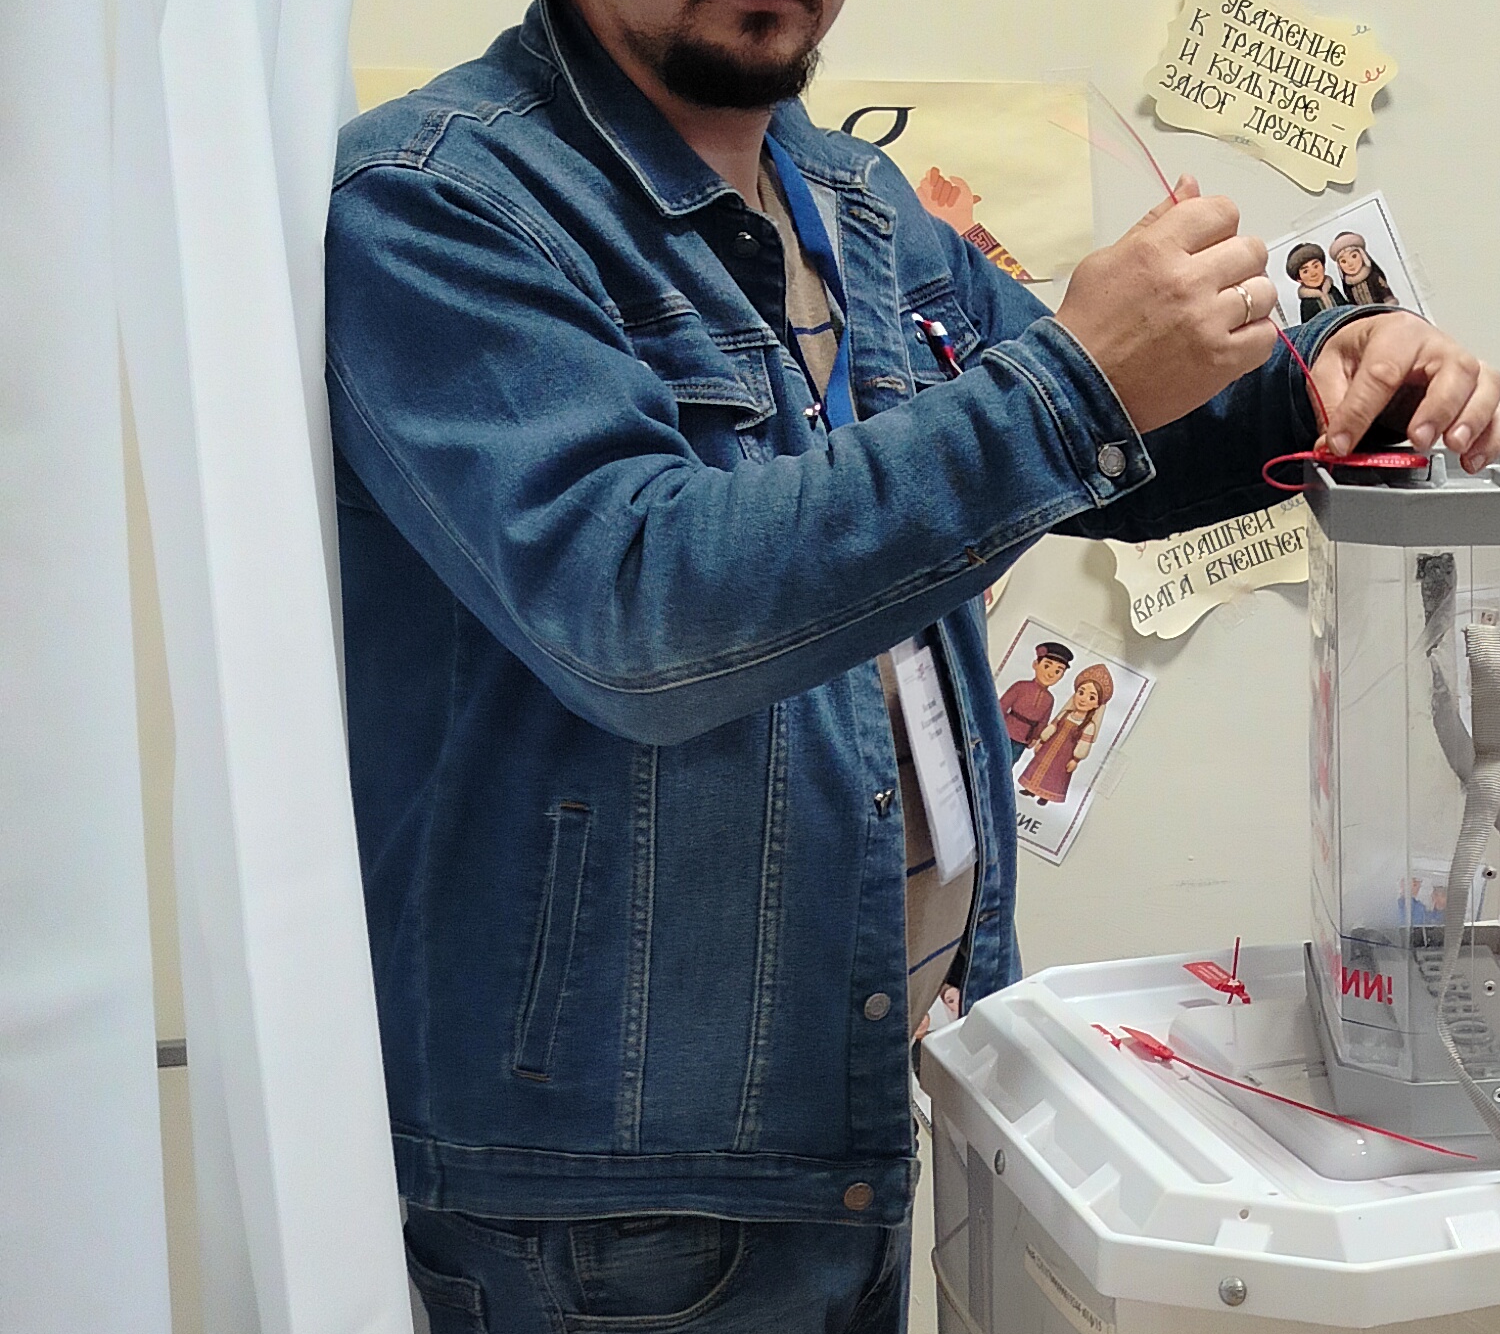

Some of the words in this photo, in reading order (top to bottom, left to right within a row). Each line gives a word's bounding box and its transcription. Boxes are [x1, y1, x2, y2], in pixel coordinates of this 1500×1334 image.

[1178, 37, 1200, 66] И
[1207, 53, 1320, 122] КУЛЬТУРЕ
[1189, 7, 1211, 37] К
[1221, 22, 1358, 108] ТРАДИЦИЯМ
[1158, 64, 1237, 115] ЗАЛОГ
[1243, 105, 1348, 168] ДРУЖБЫ
[1133, 573, 1195, 624] ВРАГА
[1205, 526, 1309, 586] ВНЕШНЕГ
